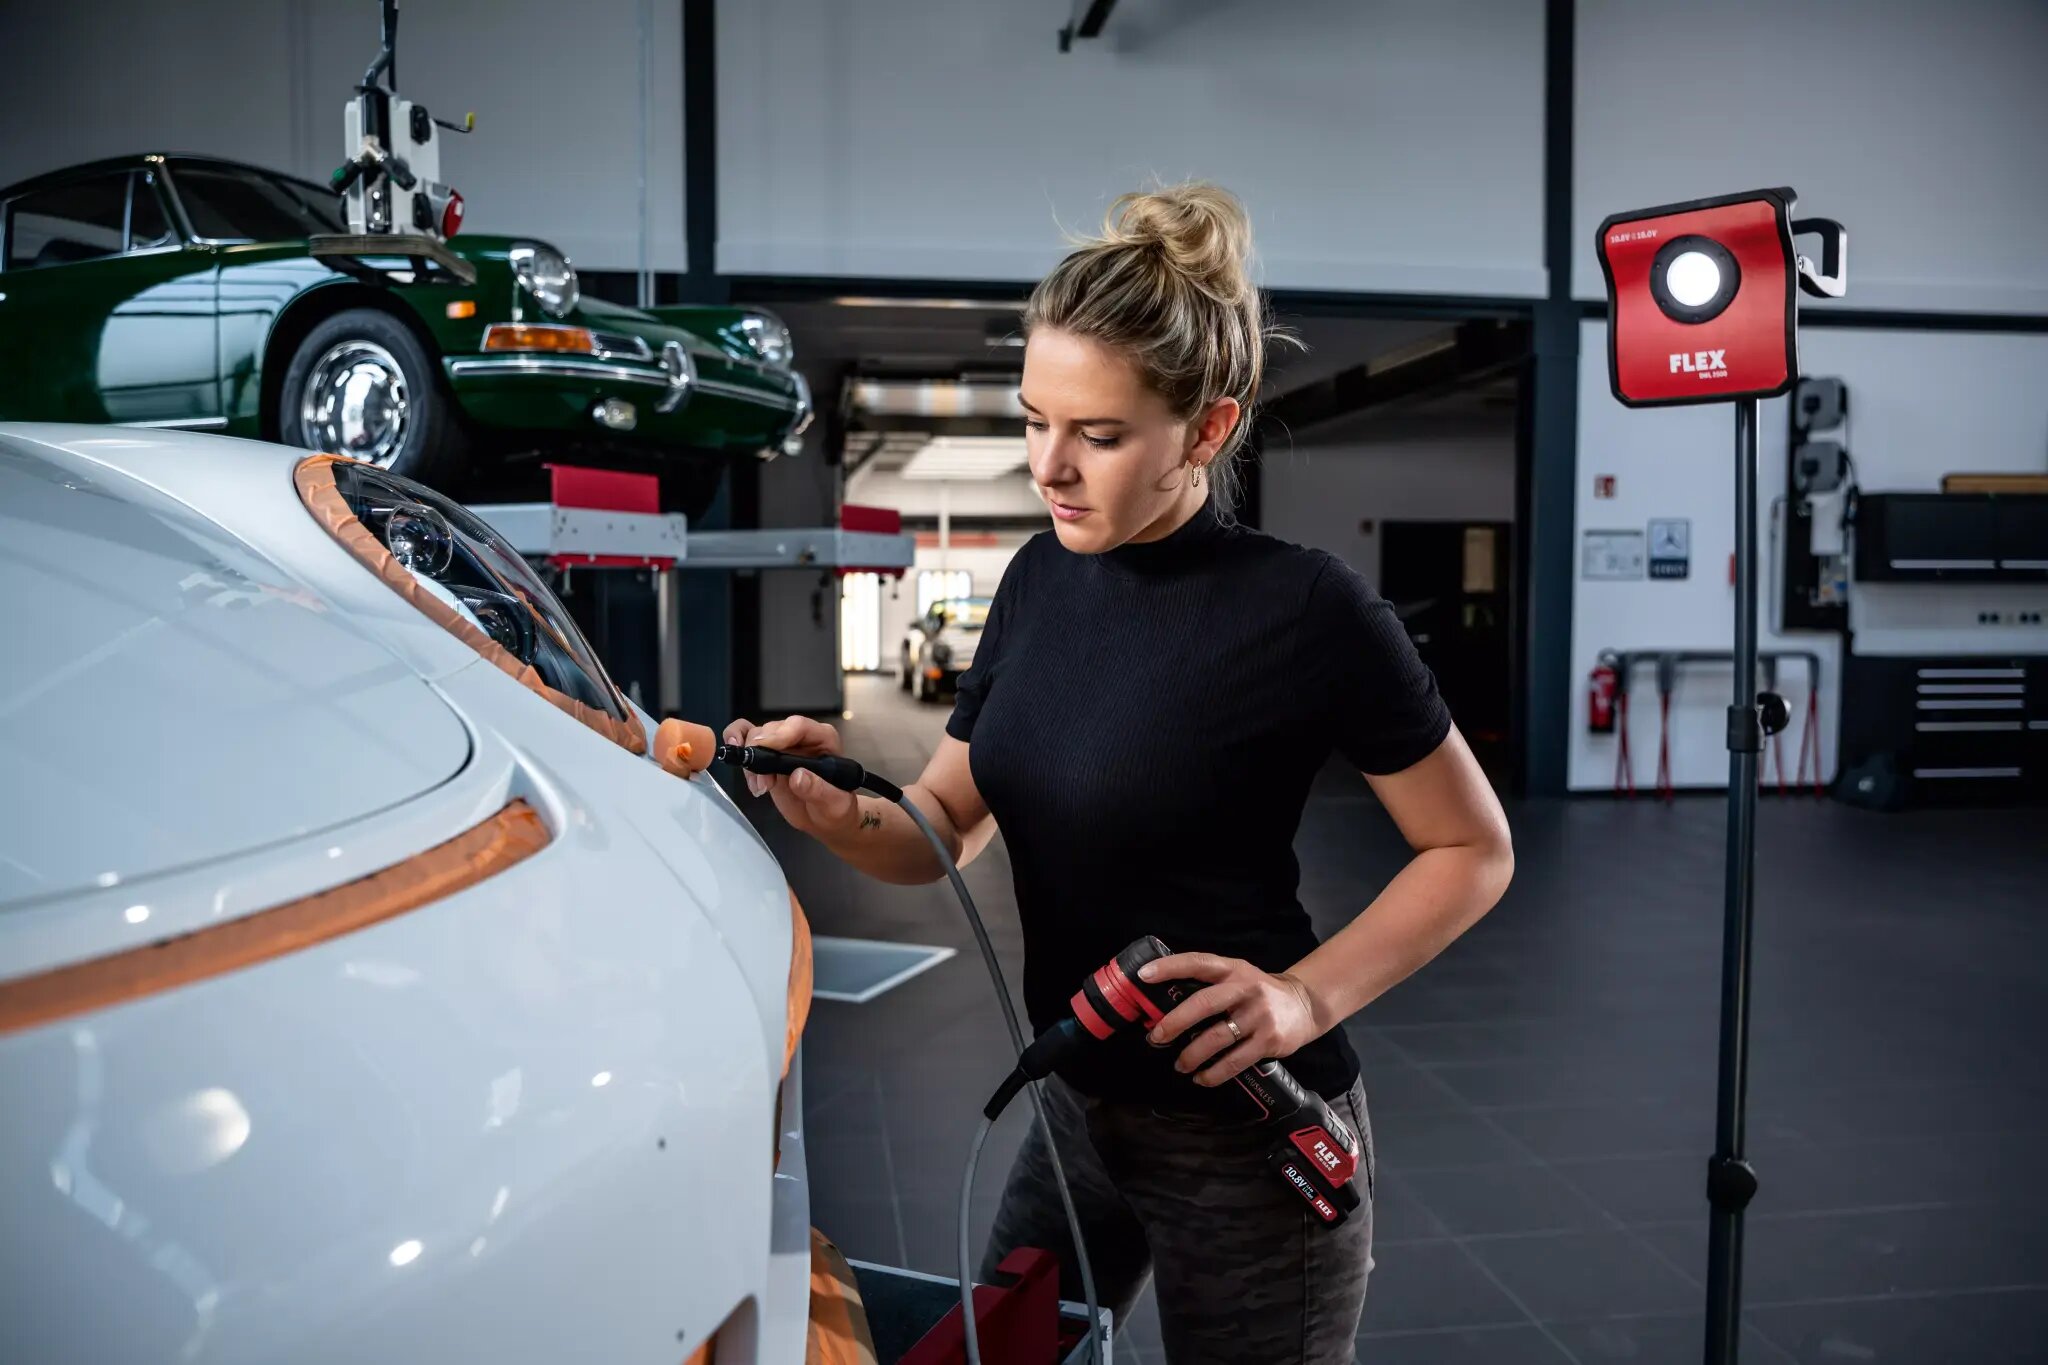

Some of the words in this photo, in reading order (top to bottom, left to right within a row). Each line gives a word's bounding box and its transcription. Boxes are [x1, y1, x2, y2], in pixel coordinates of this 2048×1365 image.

[1669, 349, 1727, 374] FLEX
[1168, 985, 1183, 1001] EC
[1313, 1141, 1341, 1169] FLEX
[1285, 1166, 1307, 1187] 10.8V
[1316, 1199, 1333, 1216] FLEX
